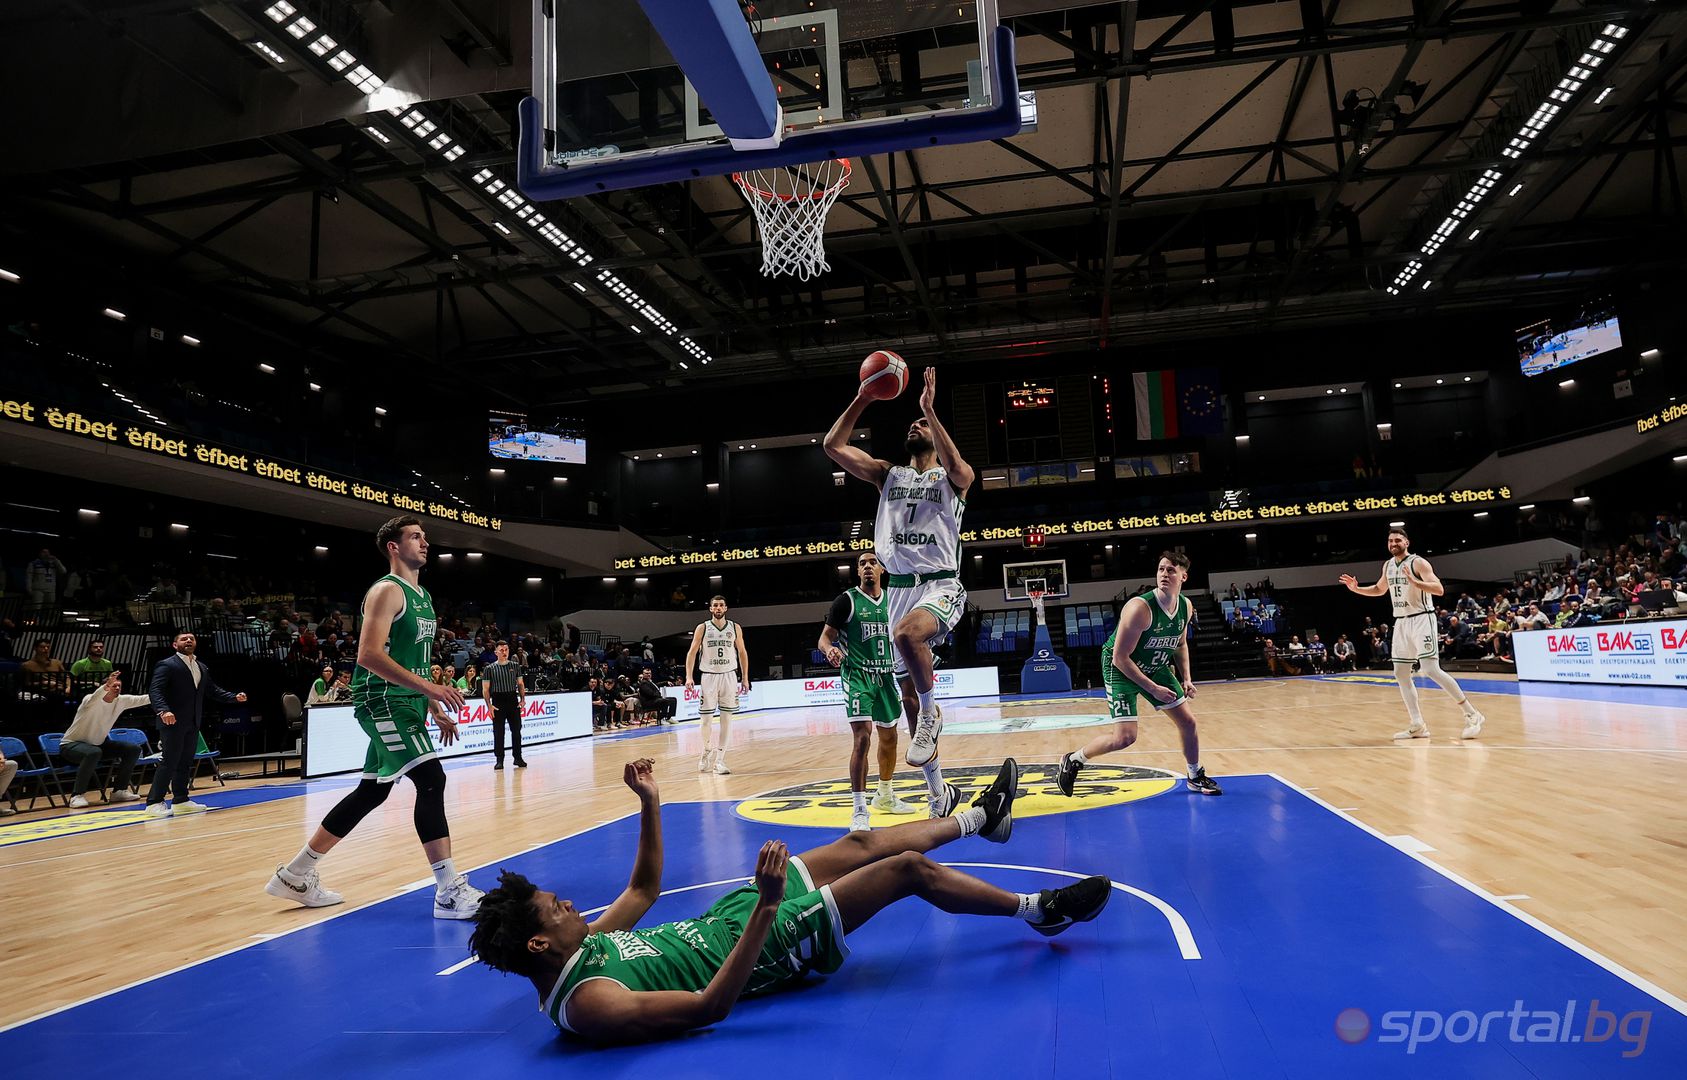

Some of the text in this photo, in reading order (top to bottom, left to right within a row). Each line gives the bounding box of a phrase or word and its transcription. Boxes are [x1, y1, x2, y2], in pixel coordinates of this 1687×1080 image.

[47, 411, 117, 440] efbet
[128, 430, 187, 456] efbet
[197, 446, 247, 471] efbet
[256, 461, 300, 483] efbet
[308, 475, 347, 494] efbet
[354, 485, 388, 504] efbet
[394, 496, 425, 512] efbet
[431, 504, 458, 520] efbet
[463, 513, 488, 527] efbet
[907, 503, 918, 524] 7
[641, 556, 676, 567] efbet
[682, 552, 717, 564] efbet
[724, 548, 758, 560] efbet
[765, 545, 801, 557] efbet
[808, 542, 844, 553] efbet
[983, 527, 1022, 539] efbet
[1074, 519, 1113, 532] efbet
[1120, 516, 1159, 529] efbet
[1166, 512, 1206, 525] efbet
[1213, 509, 1253, 521] efbet
[1260, 505, 1301, 517] efbet
[1308, 501, 1349, 514] efbet
[1355, 497, 1397, 510] efbet
[1404, 493, 1446, 506] efbet
[1452, 489, 1494, 502] efbet
[895, 533, 937, 545] SIGDA
[1394, 586, 1402, 597] 15
[877, 639, 885, 656] 9
[1147, 637, 1178, 648] BERO
[1634, 639, 1650, 650] 02
[423, 642, 431, 663] 11
[717, 648, 724, 657] 6
[1151, 650, 1170, 666] 24
[545, 706, 556, 715] 02
[852, 699, 860, 715] 9
[1113, 700, 1131, 716] 24
[411, 733, 431, 755] 11
